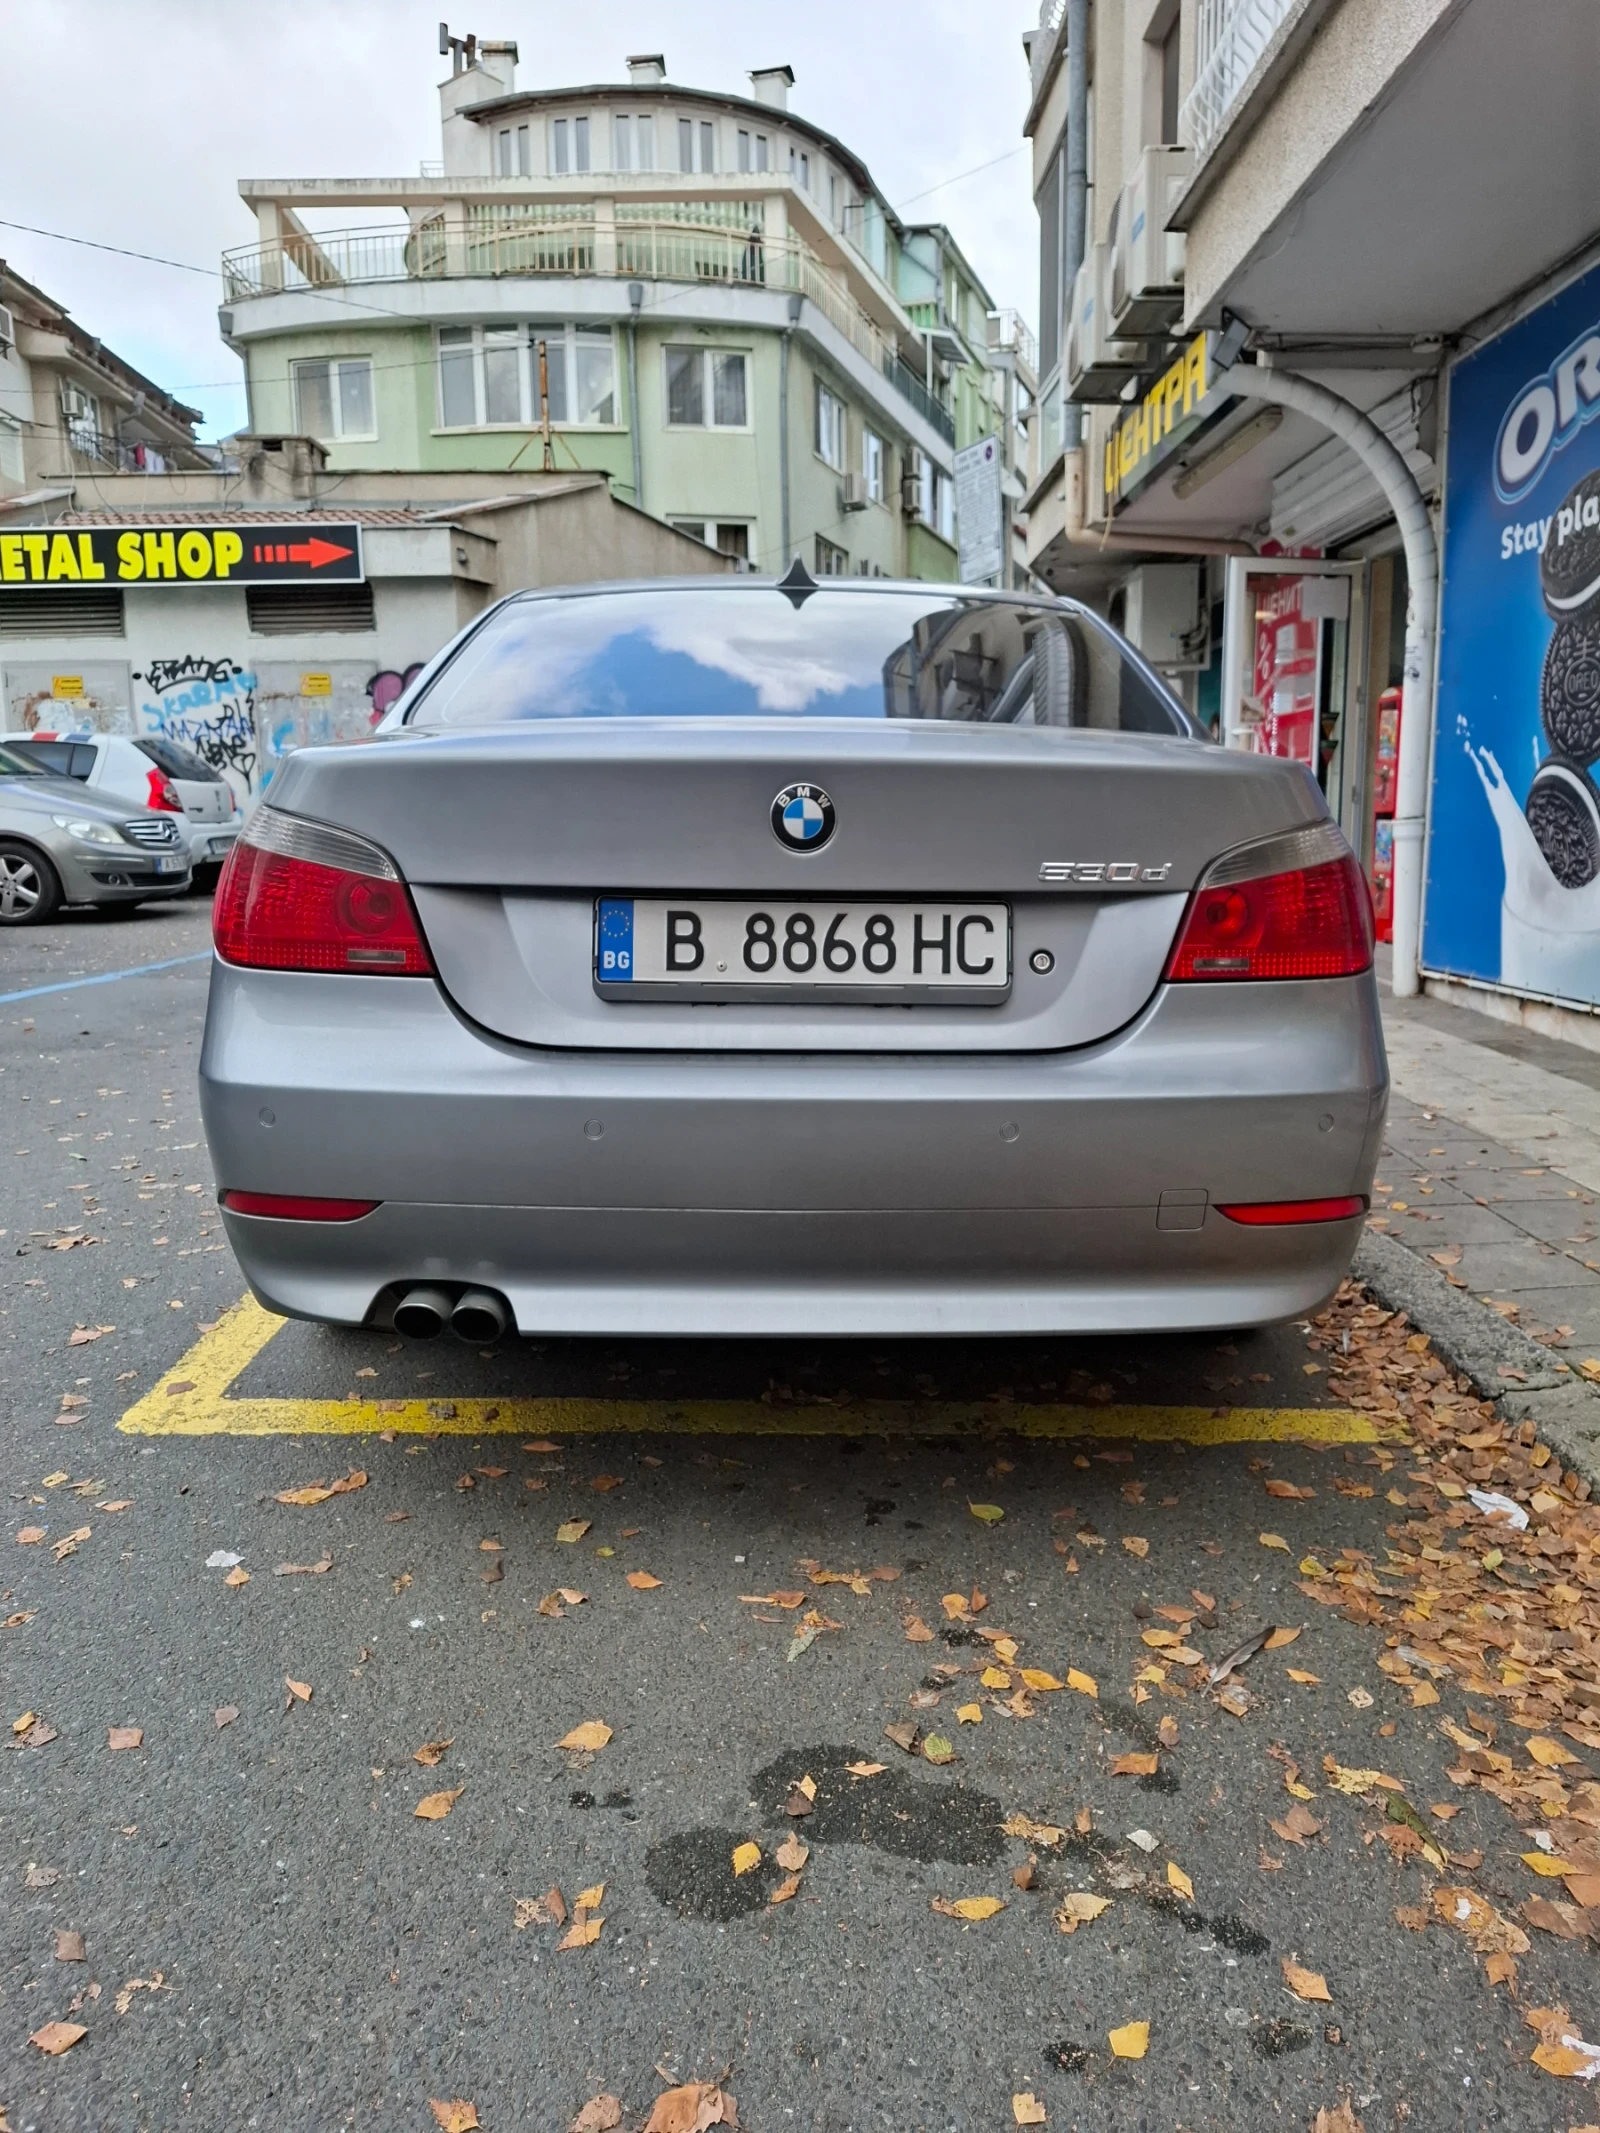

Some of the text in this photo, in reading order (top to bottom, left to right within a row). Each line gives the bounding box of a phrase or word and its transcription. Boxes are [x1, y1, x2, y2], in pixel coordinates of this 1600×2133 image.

[1105, 331, 1207, 493] ЦЕНТРА
[1500, 493, 1600, 561] Stay pla
[0, 531, 243, 581] ETAL SHOP
[1568, 669, 1599, 694] OREO
[777, 786, 831, 809] BMW
[1038, 861, 1172, 882] 530d
[665, 910, 705, 972] B
[602, 950, 631, 970] BG
